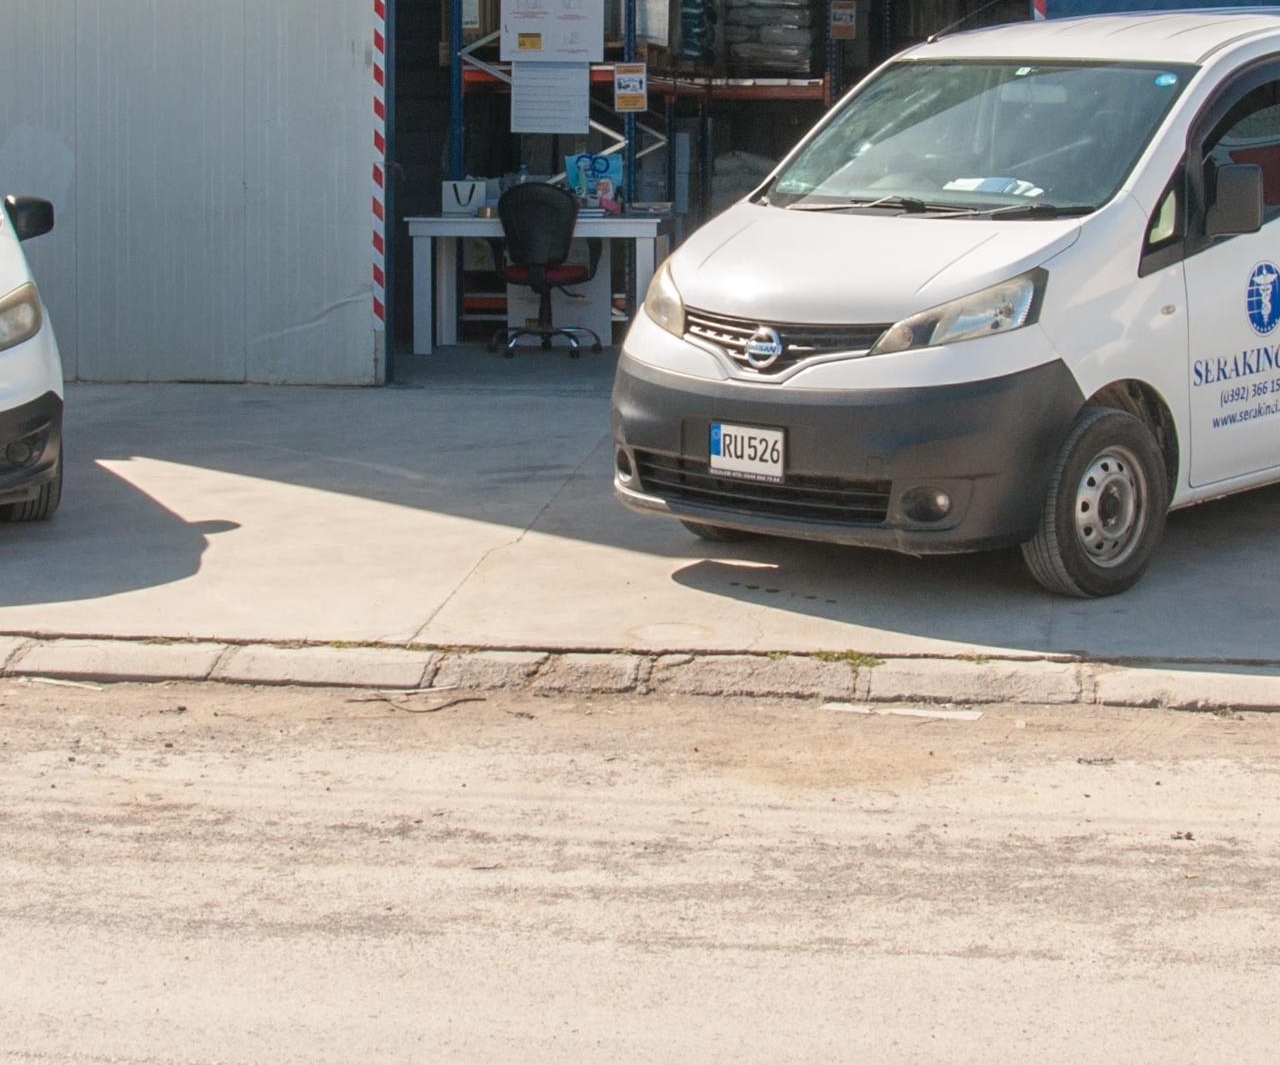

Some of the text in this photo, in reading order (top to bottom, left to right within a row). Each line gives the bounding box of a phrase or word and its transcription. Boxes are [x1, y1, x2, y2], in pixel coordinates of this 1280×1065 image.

[1220, 385, 1249, 407] (0392)
[1251, 381, 1268, 399] 366
[1270, 377, 1280, 394] 15
[723, 433, 781, 465] RU 526
